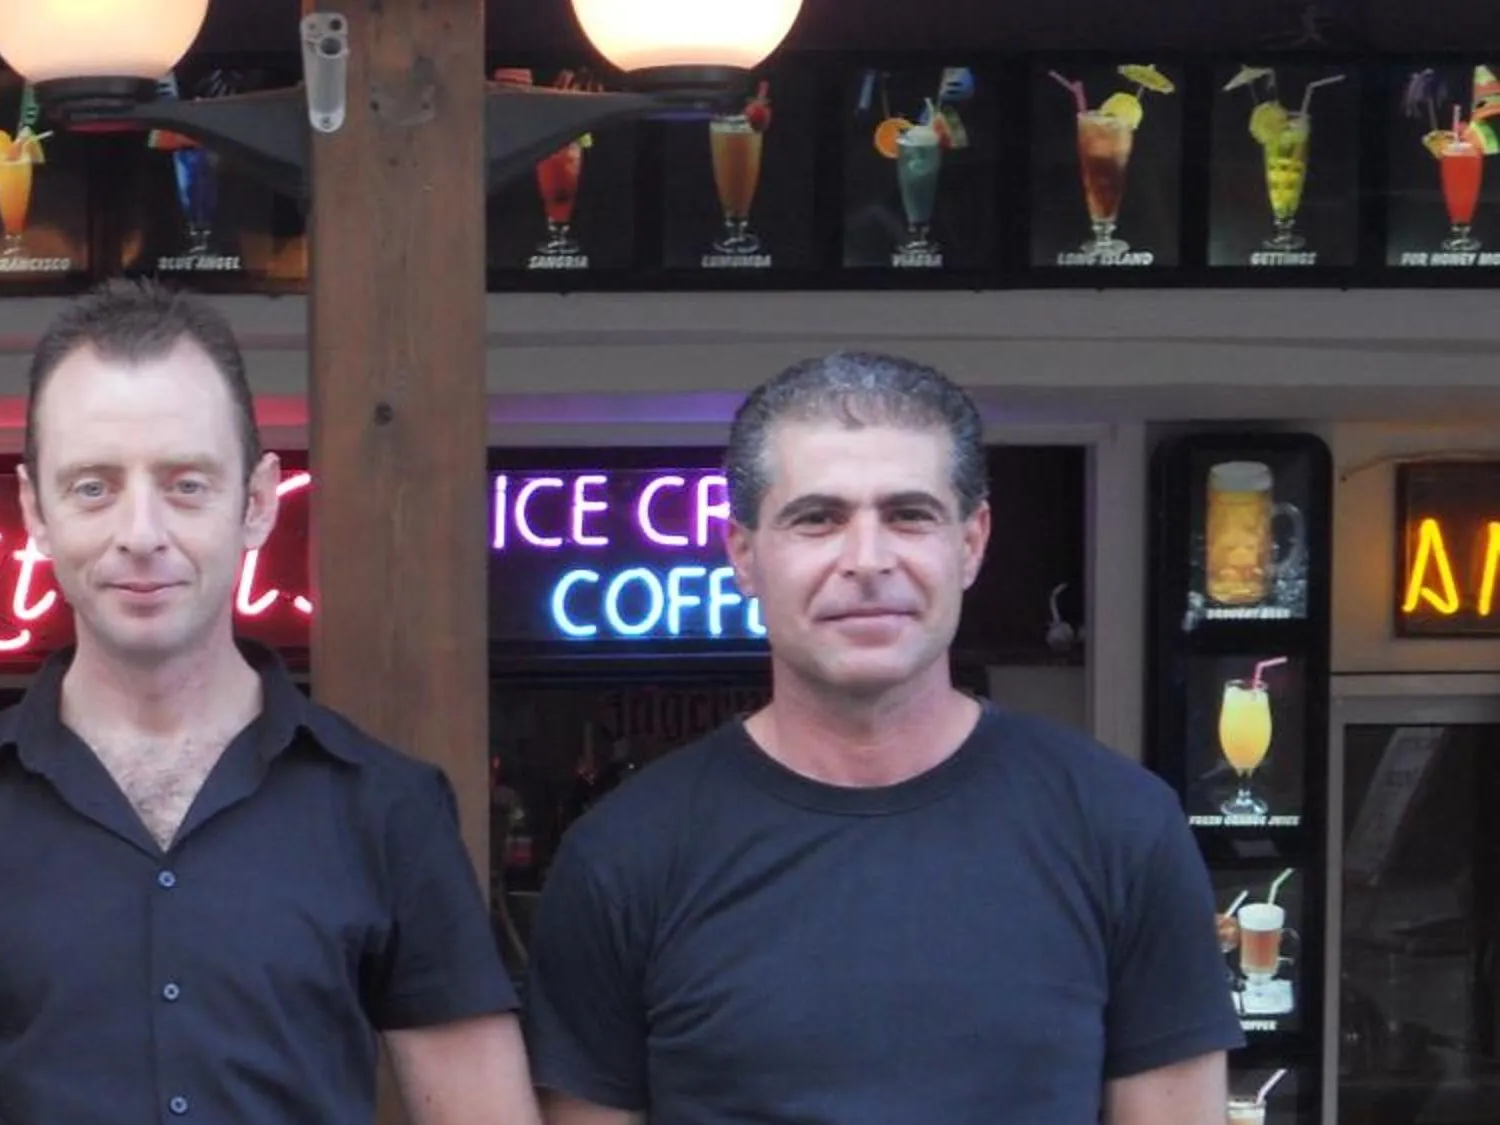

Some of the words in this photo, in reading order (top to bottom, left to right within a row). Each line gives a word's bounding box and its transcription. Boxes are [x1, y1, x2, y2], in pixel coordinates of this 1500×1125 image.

[158, 257, 196, 270] BLUE
[199, 256, 241, 270] ANGEL
[1057, 252, 1096, 266] LONG
[1099, 252, 1154, 266] ISLAND
[1401, 252, 1428, 266] FOR
[1429, 252, 1476, 266] MONEY
[492, 474, 609, 549] ICE
[551, 566, 768, 637] COFF
[1268, 815, 1300, 826] JUICE
